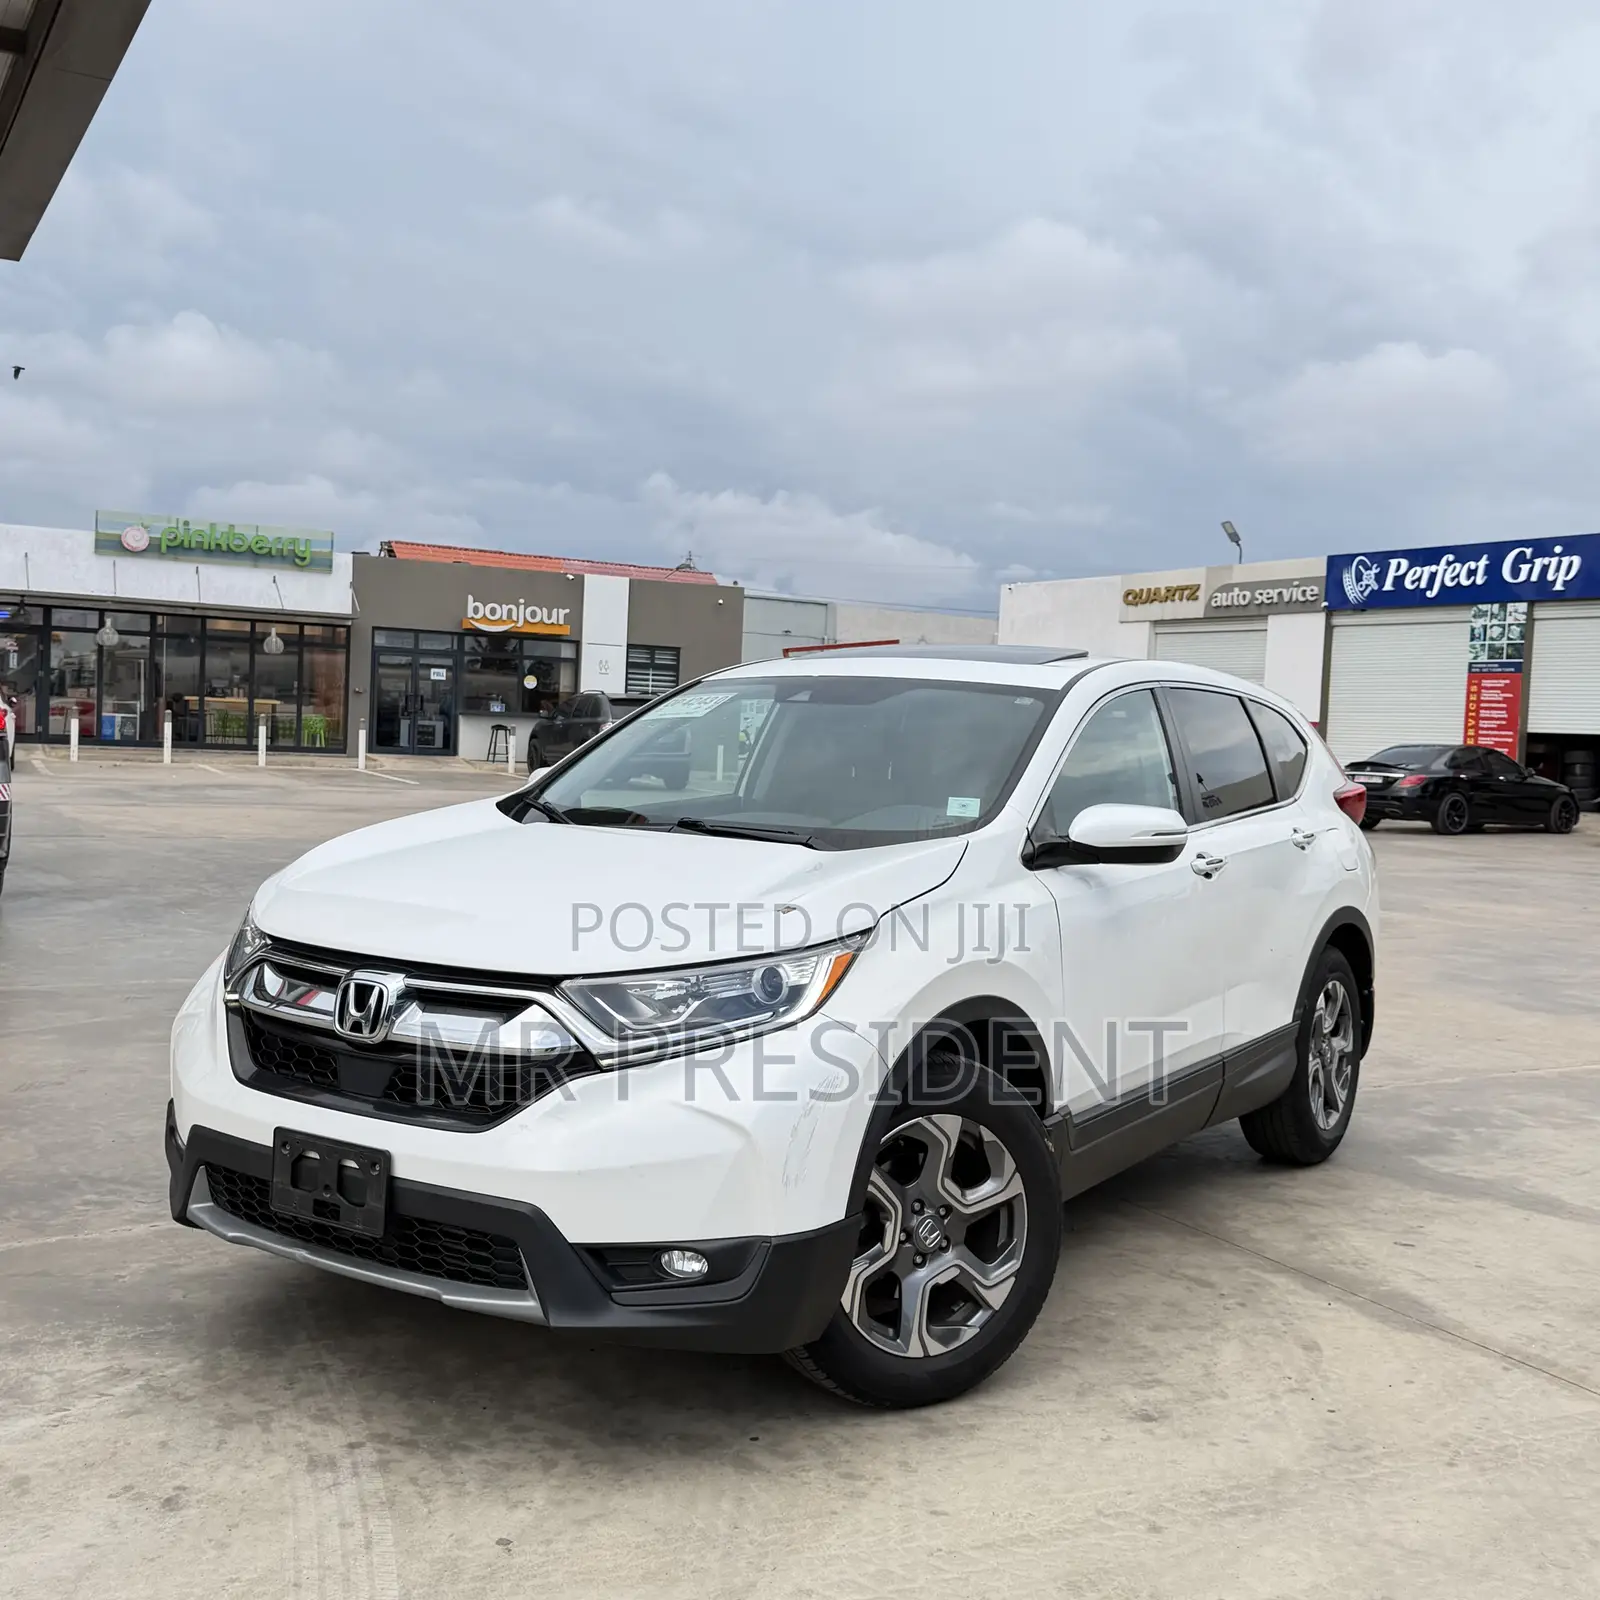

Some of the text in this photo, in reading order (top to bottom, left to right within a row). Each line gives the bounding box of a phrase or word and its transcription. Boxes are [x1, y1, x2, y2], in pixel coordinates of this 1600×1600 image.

[160, 519, 312, 567] pinkberry
[1381, 545, 1582, 599] Perfect Grip
[467, 594, 571, 628] bonjour
[1122, 583, 1201, 607] QUARTZ
[1210, 581, 1320, 608] auto service
